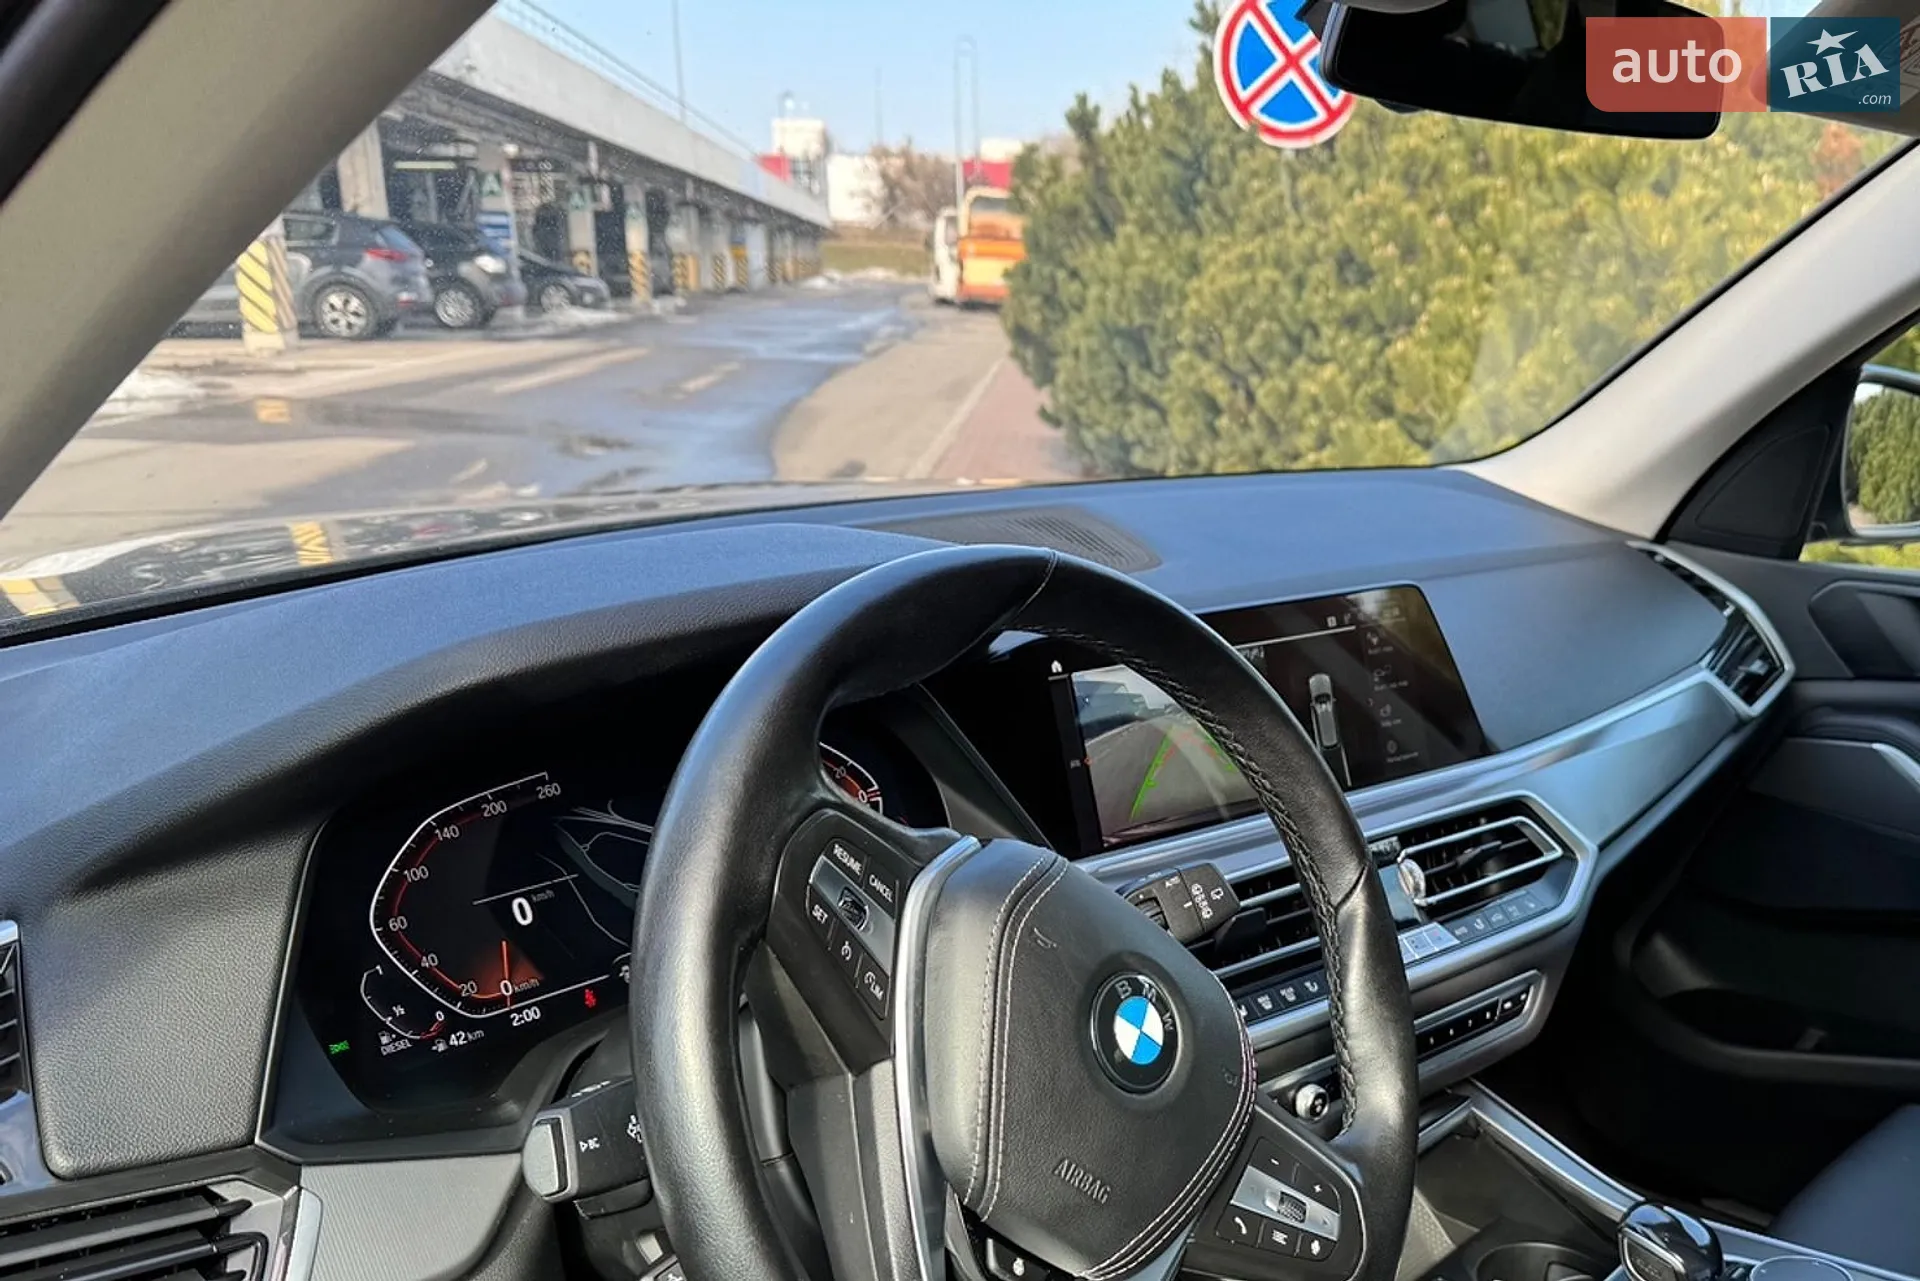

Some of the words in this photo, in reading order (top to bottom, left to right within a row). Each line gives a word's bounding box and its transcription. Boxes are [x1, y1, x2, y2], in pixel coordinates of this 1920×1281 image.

[536, 783, 561, 800] 260
[858, 792, 868, 803] 0
[481, 800, 507, 818] 200
[435, 825, 460, 841] 140
[832, 844, 863, 875] RESUME
[404, 865, 429, 882] 100
[868, 873, 894, 903] CANCEL
[512, 896, 534, 926] 0
[388, 915, 408, 932] 60
[420, 952, 439, 969] 40
[458, 980, 478, 998] 20
[499, 979, 513, 997] 0
[1115, 980, 1176, 1031] BMW
[435, 1010, 445, 1022] 0
[510, 1005, 541, 1027] 2:00
[380, 1038, 413, 1056] DIESEL
[449, 1030, 468, 1047] 42
[467, 1029, 485, 1041] km
[1052, 1158, 1112, 1204] AIRBAG
